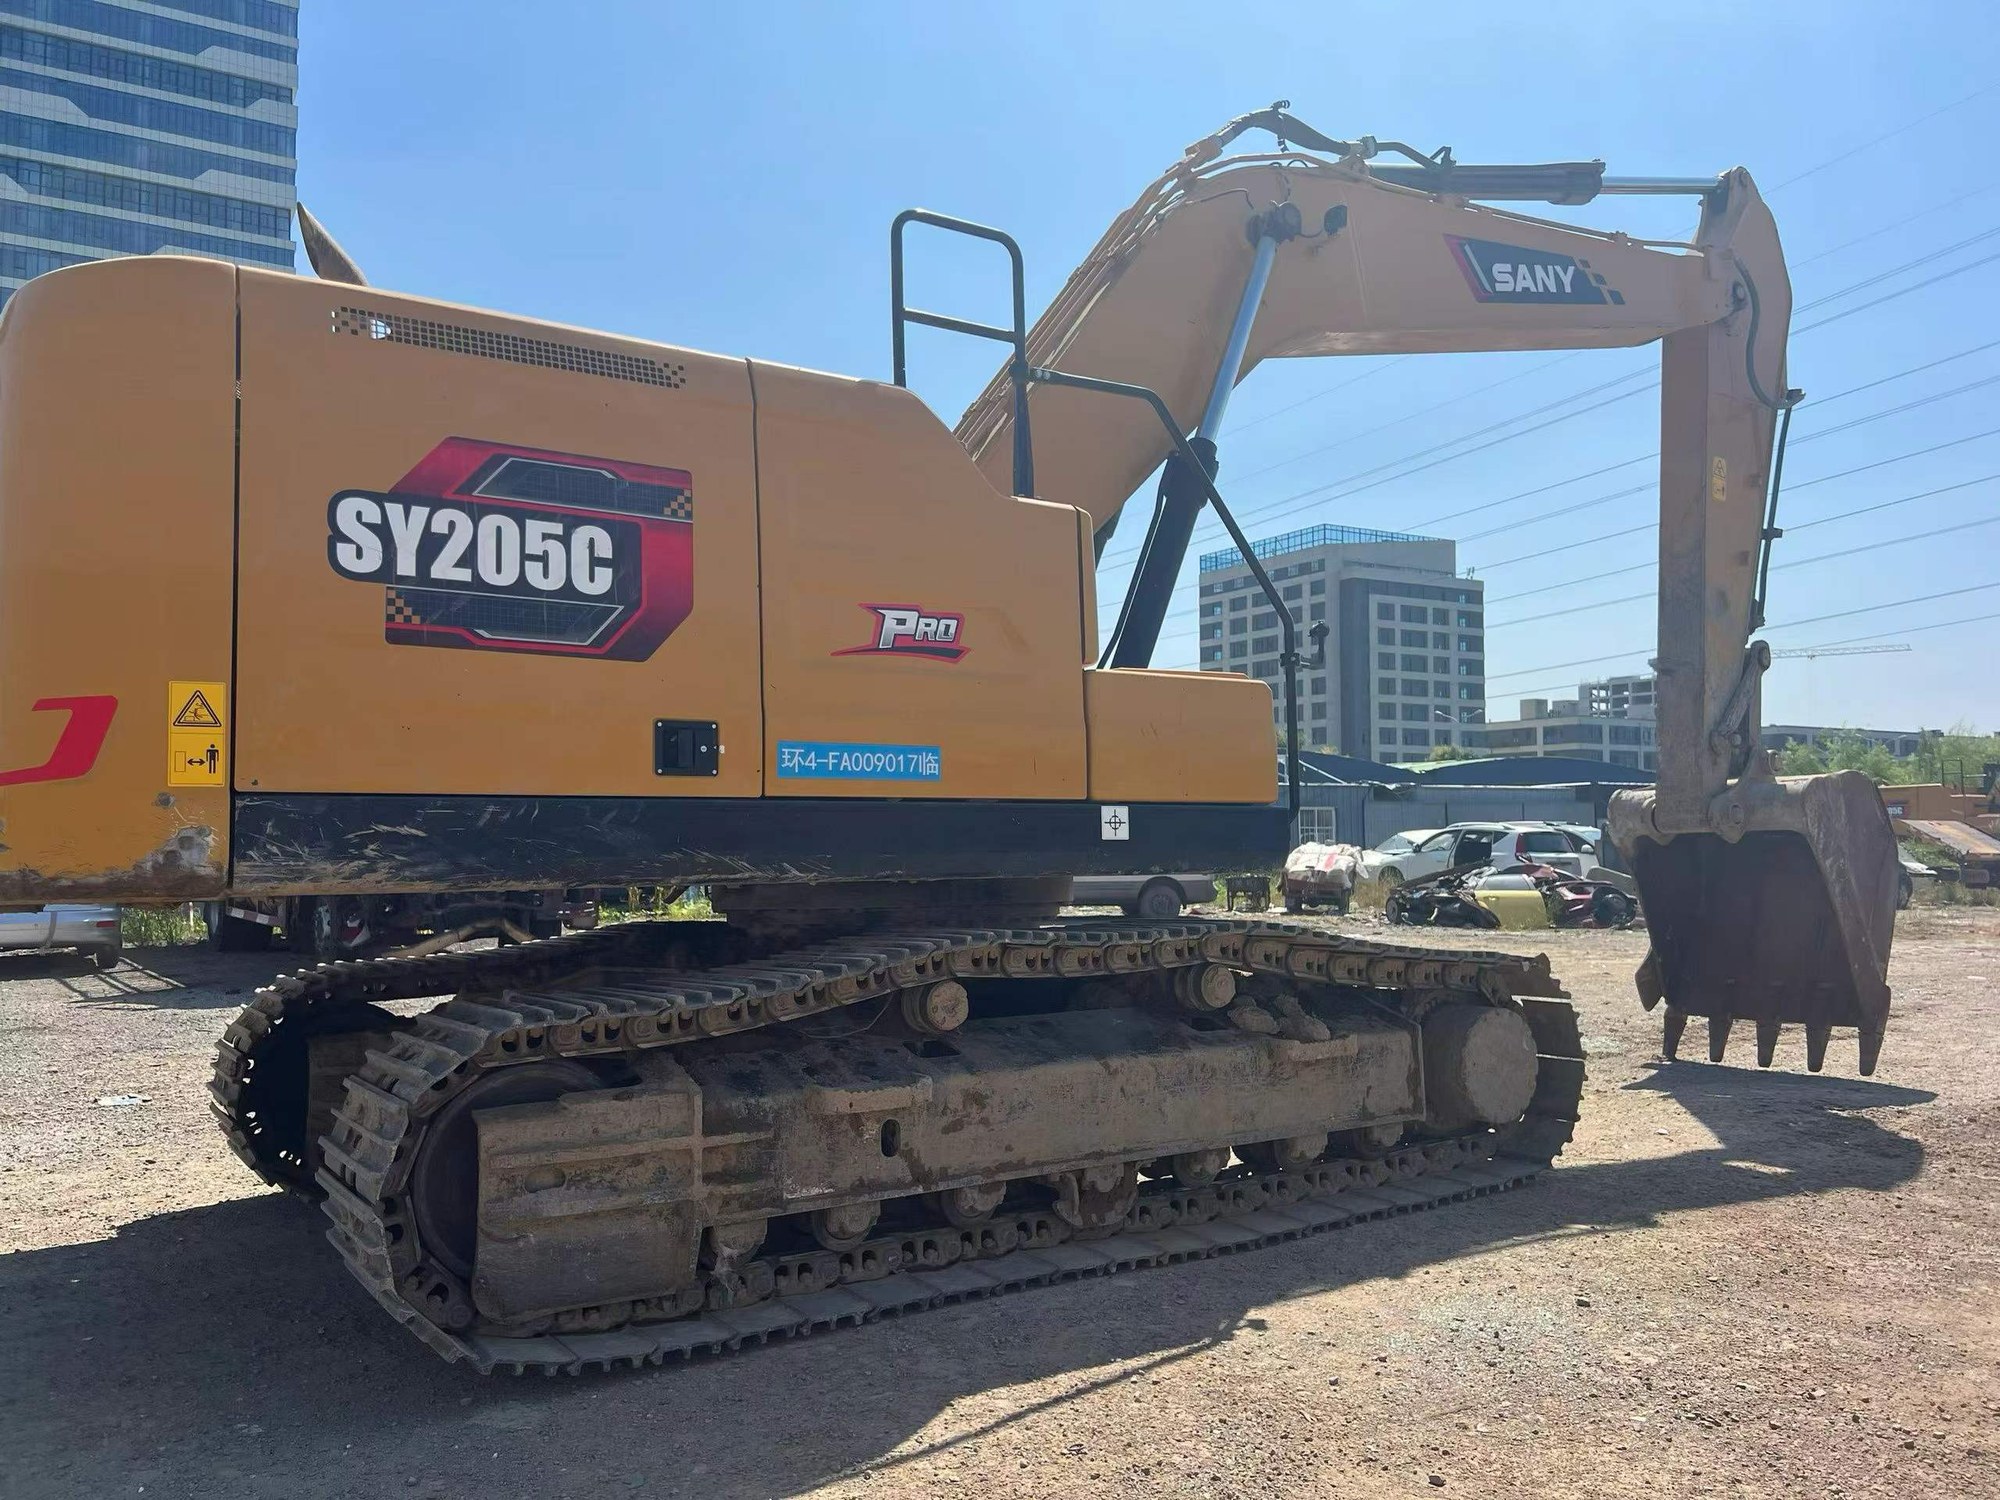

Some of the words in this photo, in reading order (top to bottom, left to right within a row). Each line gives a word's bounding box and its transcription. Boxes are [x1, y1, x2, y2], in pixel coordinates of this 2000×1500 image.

[1491, 263, 1575, 293] SANY
[336, 497, 613, 595] SY205C
[781, 748, 939, 776] 环4-FA009017临
